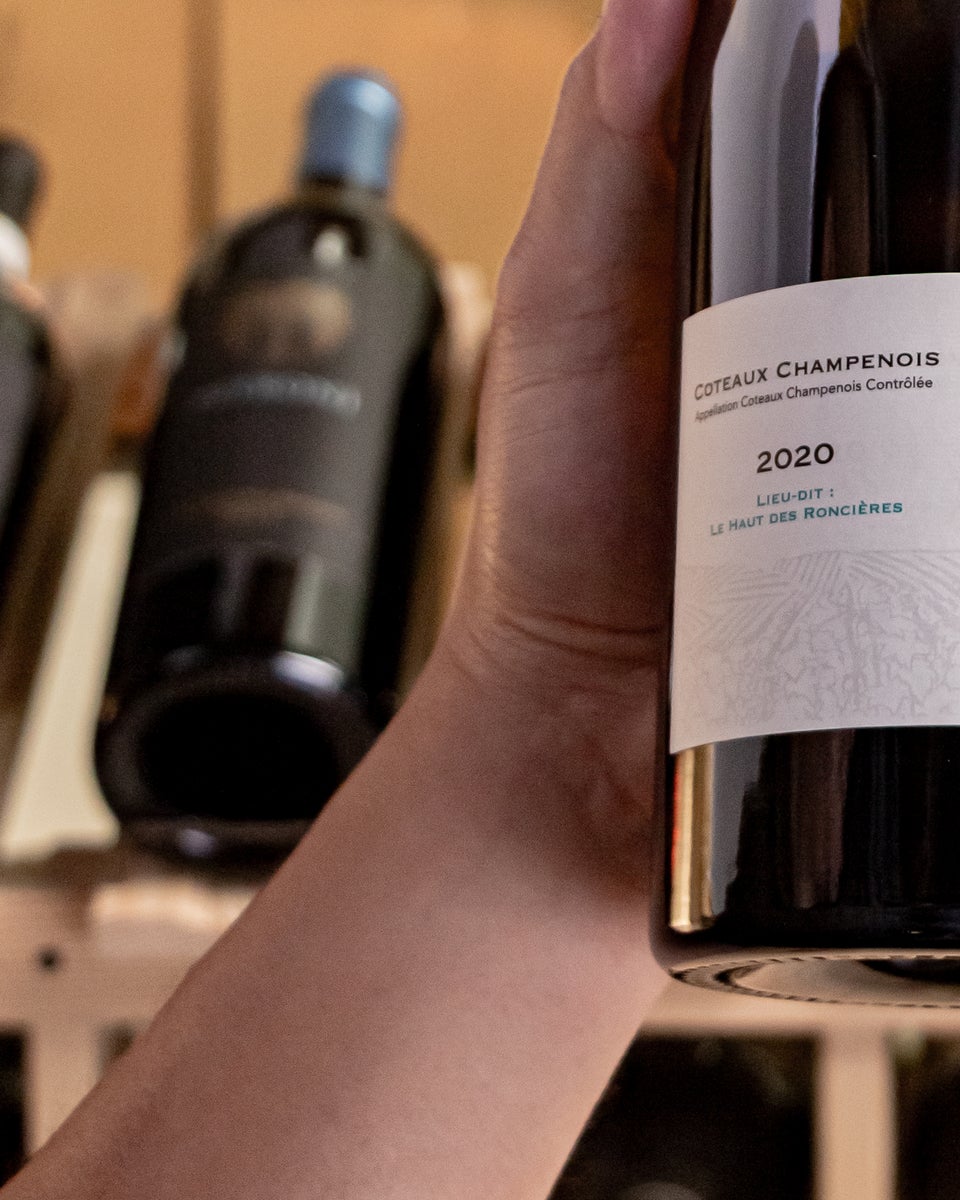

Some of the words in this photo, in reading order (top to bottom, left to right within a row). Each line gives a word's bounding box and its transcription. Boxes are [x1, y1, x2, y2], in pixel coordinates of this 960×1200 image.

[695, 400, 738, 424] Appellation
[740, 392, 784, 409] Coteaux
[786, 381, 862, 402] Champenois
[865, 376, 934, 392] Contrôlée
[756, 443, 835, 474] 2020
